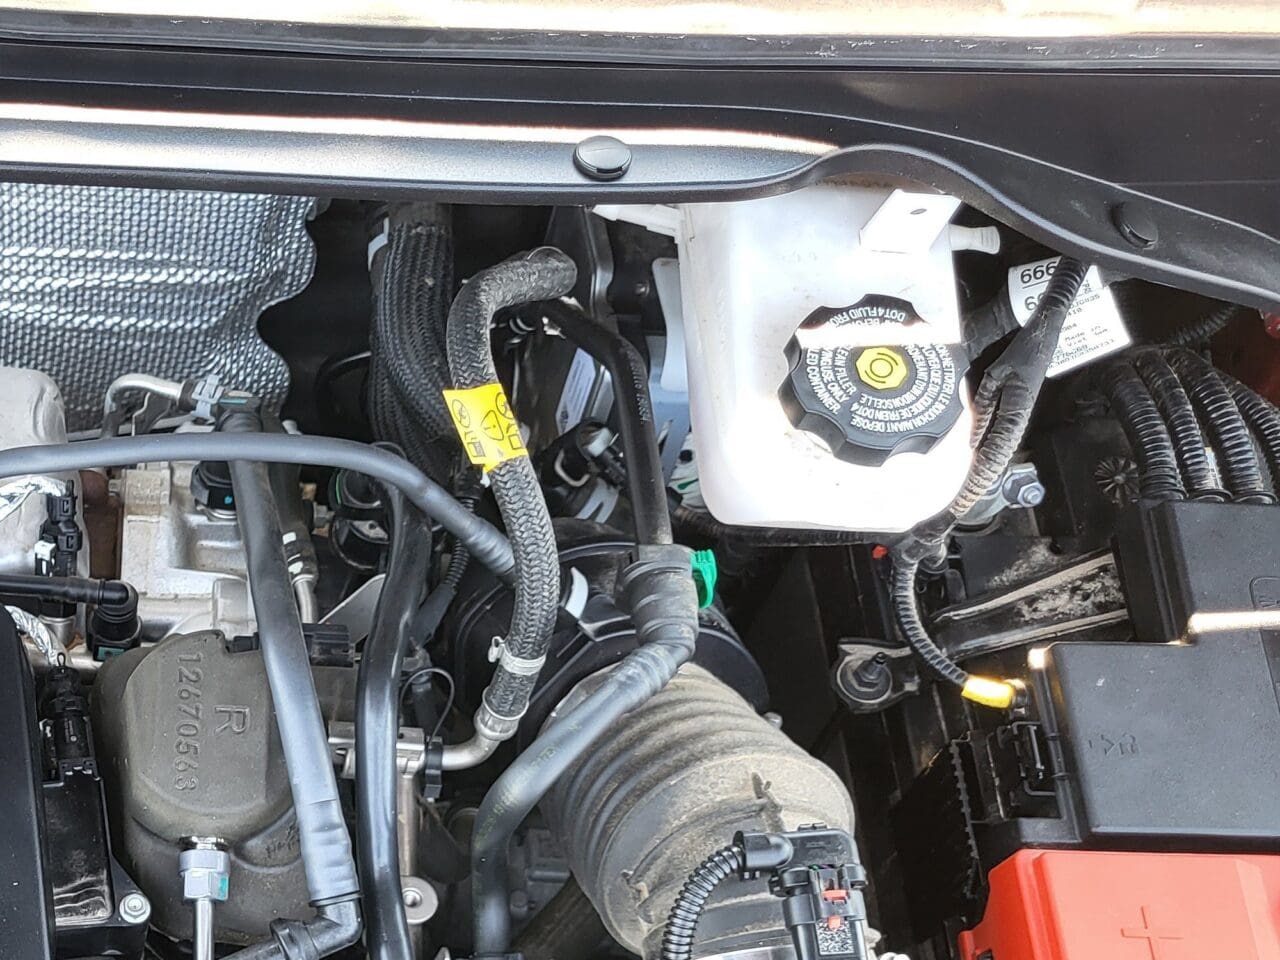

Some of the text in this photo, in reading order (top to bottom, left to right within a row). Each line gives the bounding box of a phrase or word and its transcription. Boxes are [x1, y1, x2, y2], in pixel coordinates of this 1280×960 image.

[848, 306, 877, 319] FLUID
[884, 308, 906, 322] DOT
[835, 367, 857, 395] FILLER
[827, 382, 850, 403] ONLY
[857, 405, 874, 419] DOT
[213, 705, 251, 737] R
